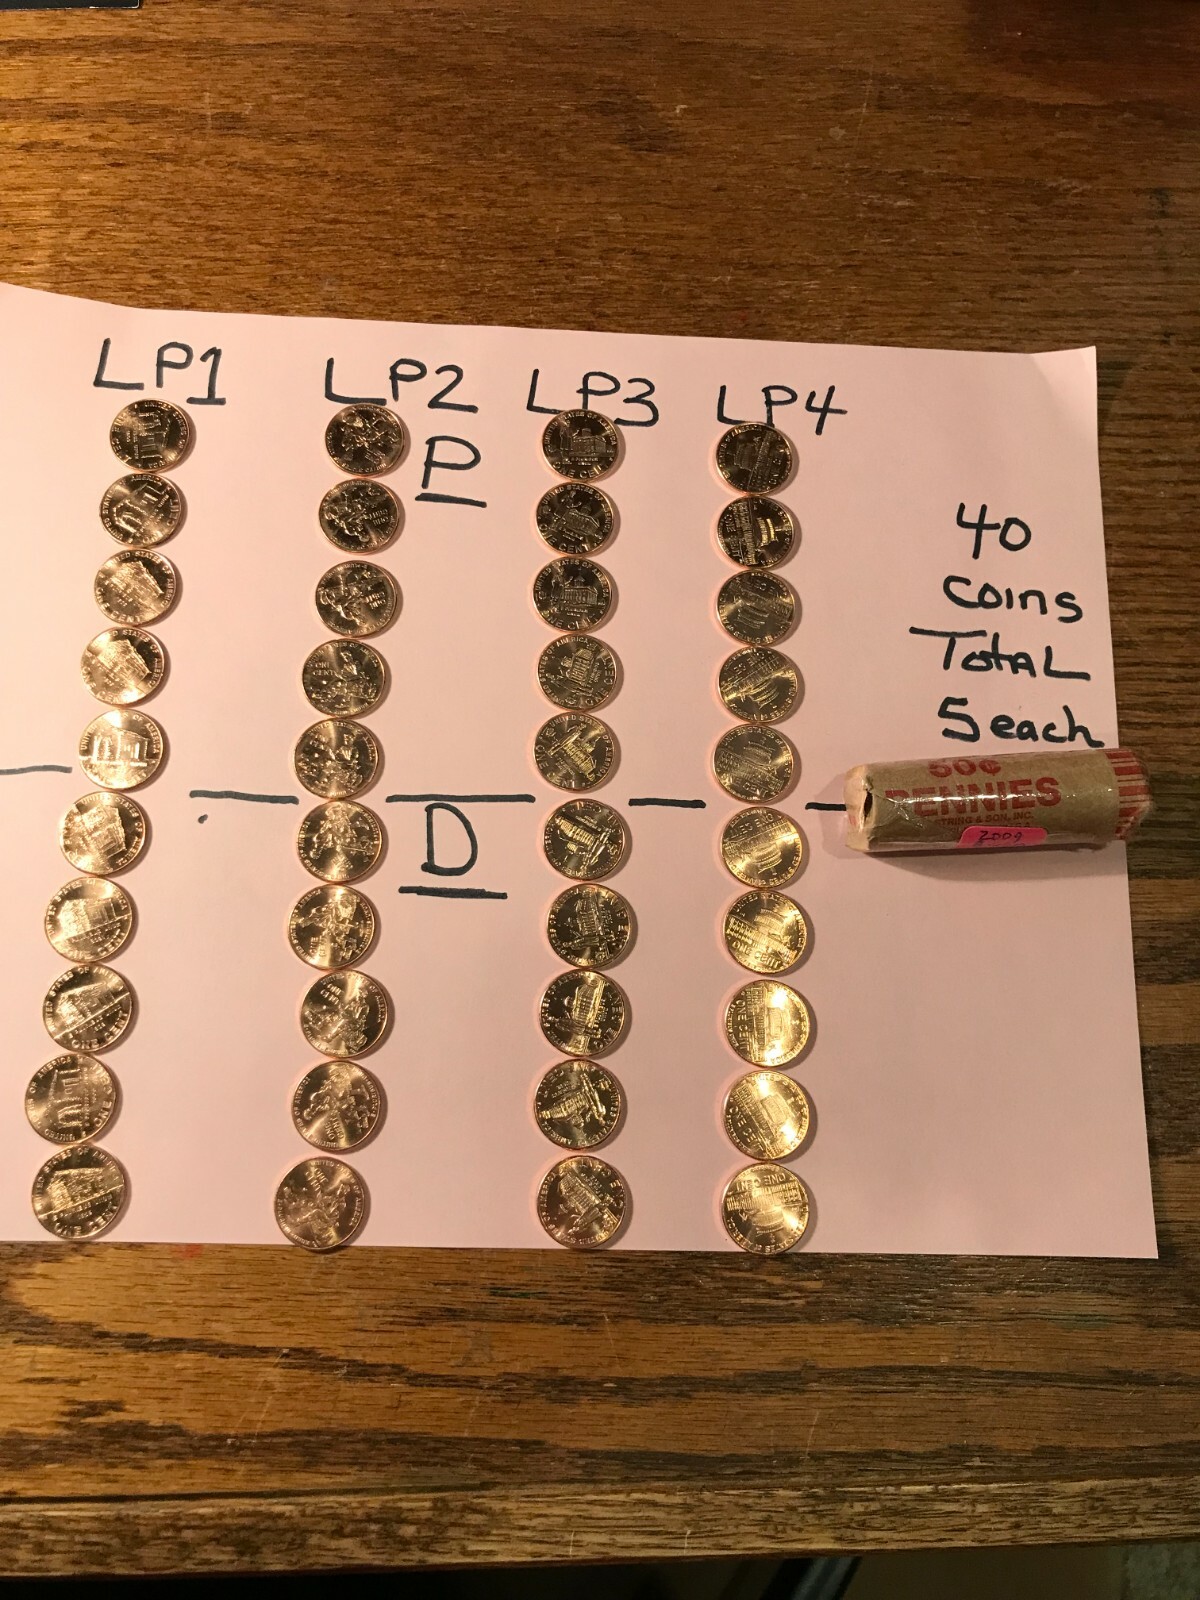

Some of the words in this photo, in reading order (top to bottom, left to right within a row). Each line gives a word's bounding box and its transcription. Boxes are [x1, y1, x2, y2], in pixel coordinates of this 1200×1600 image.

[93, 337, 227, 405] LP1
[325, 357, 479, 414] LP2
[526, 368, 660, 428] LP3
[717, 384, 848, 436] LP4
[421, 435, 481, 489] P
[956, 501, 1032, 560] 40
[989, 704, 1106, 748] each
[420, 802, 478, 877] D
